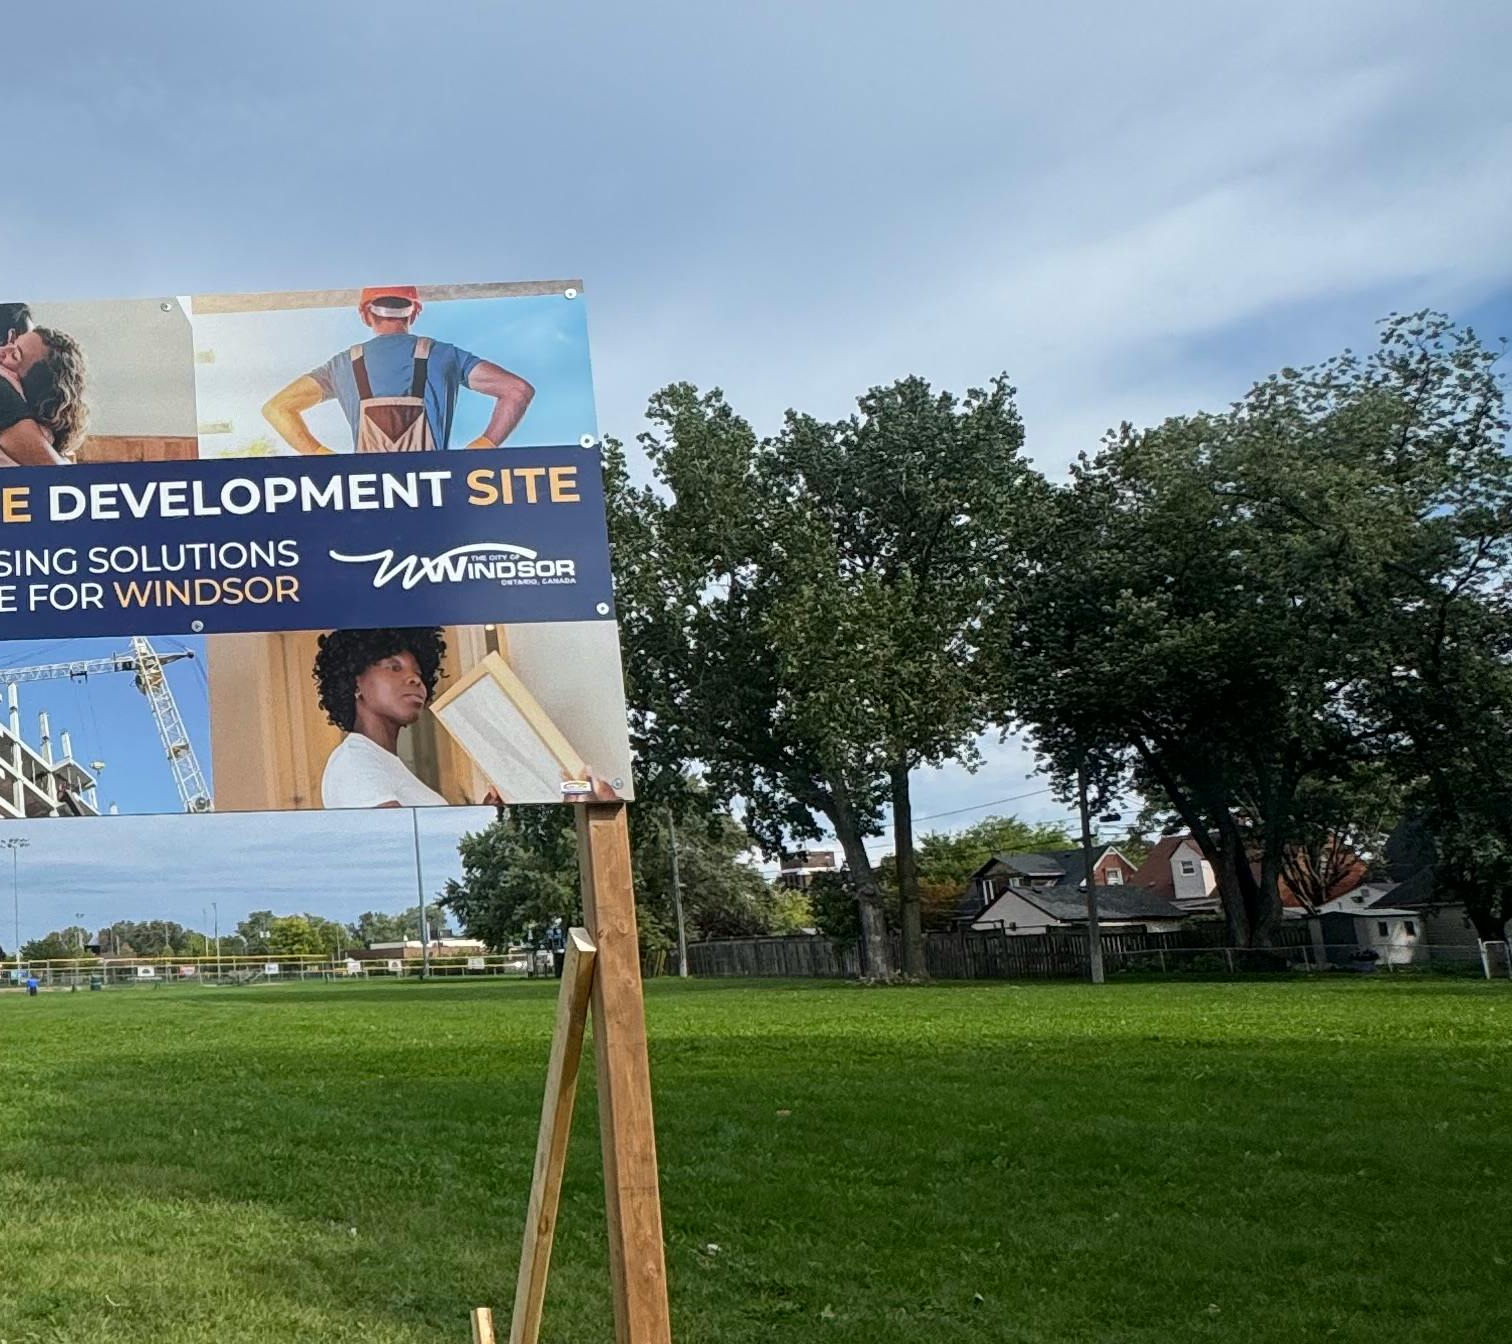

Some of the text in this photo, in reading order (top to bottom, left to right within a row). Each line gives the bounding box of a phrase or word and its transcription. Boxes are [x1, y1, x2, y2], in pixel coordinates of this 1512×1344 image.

[49, 470, 452, 521] DEVELOPMENT
[466, 465, 581, 506] SITE
[88, 539, 300, 574] SOLUTIONS
[420, 555, 576, 583] WINDSOR
[470, 554, 488, 562] THE
[29, 582, 104, 612] FOR
[113, 575, 300, 608] WINDSOR
